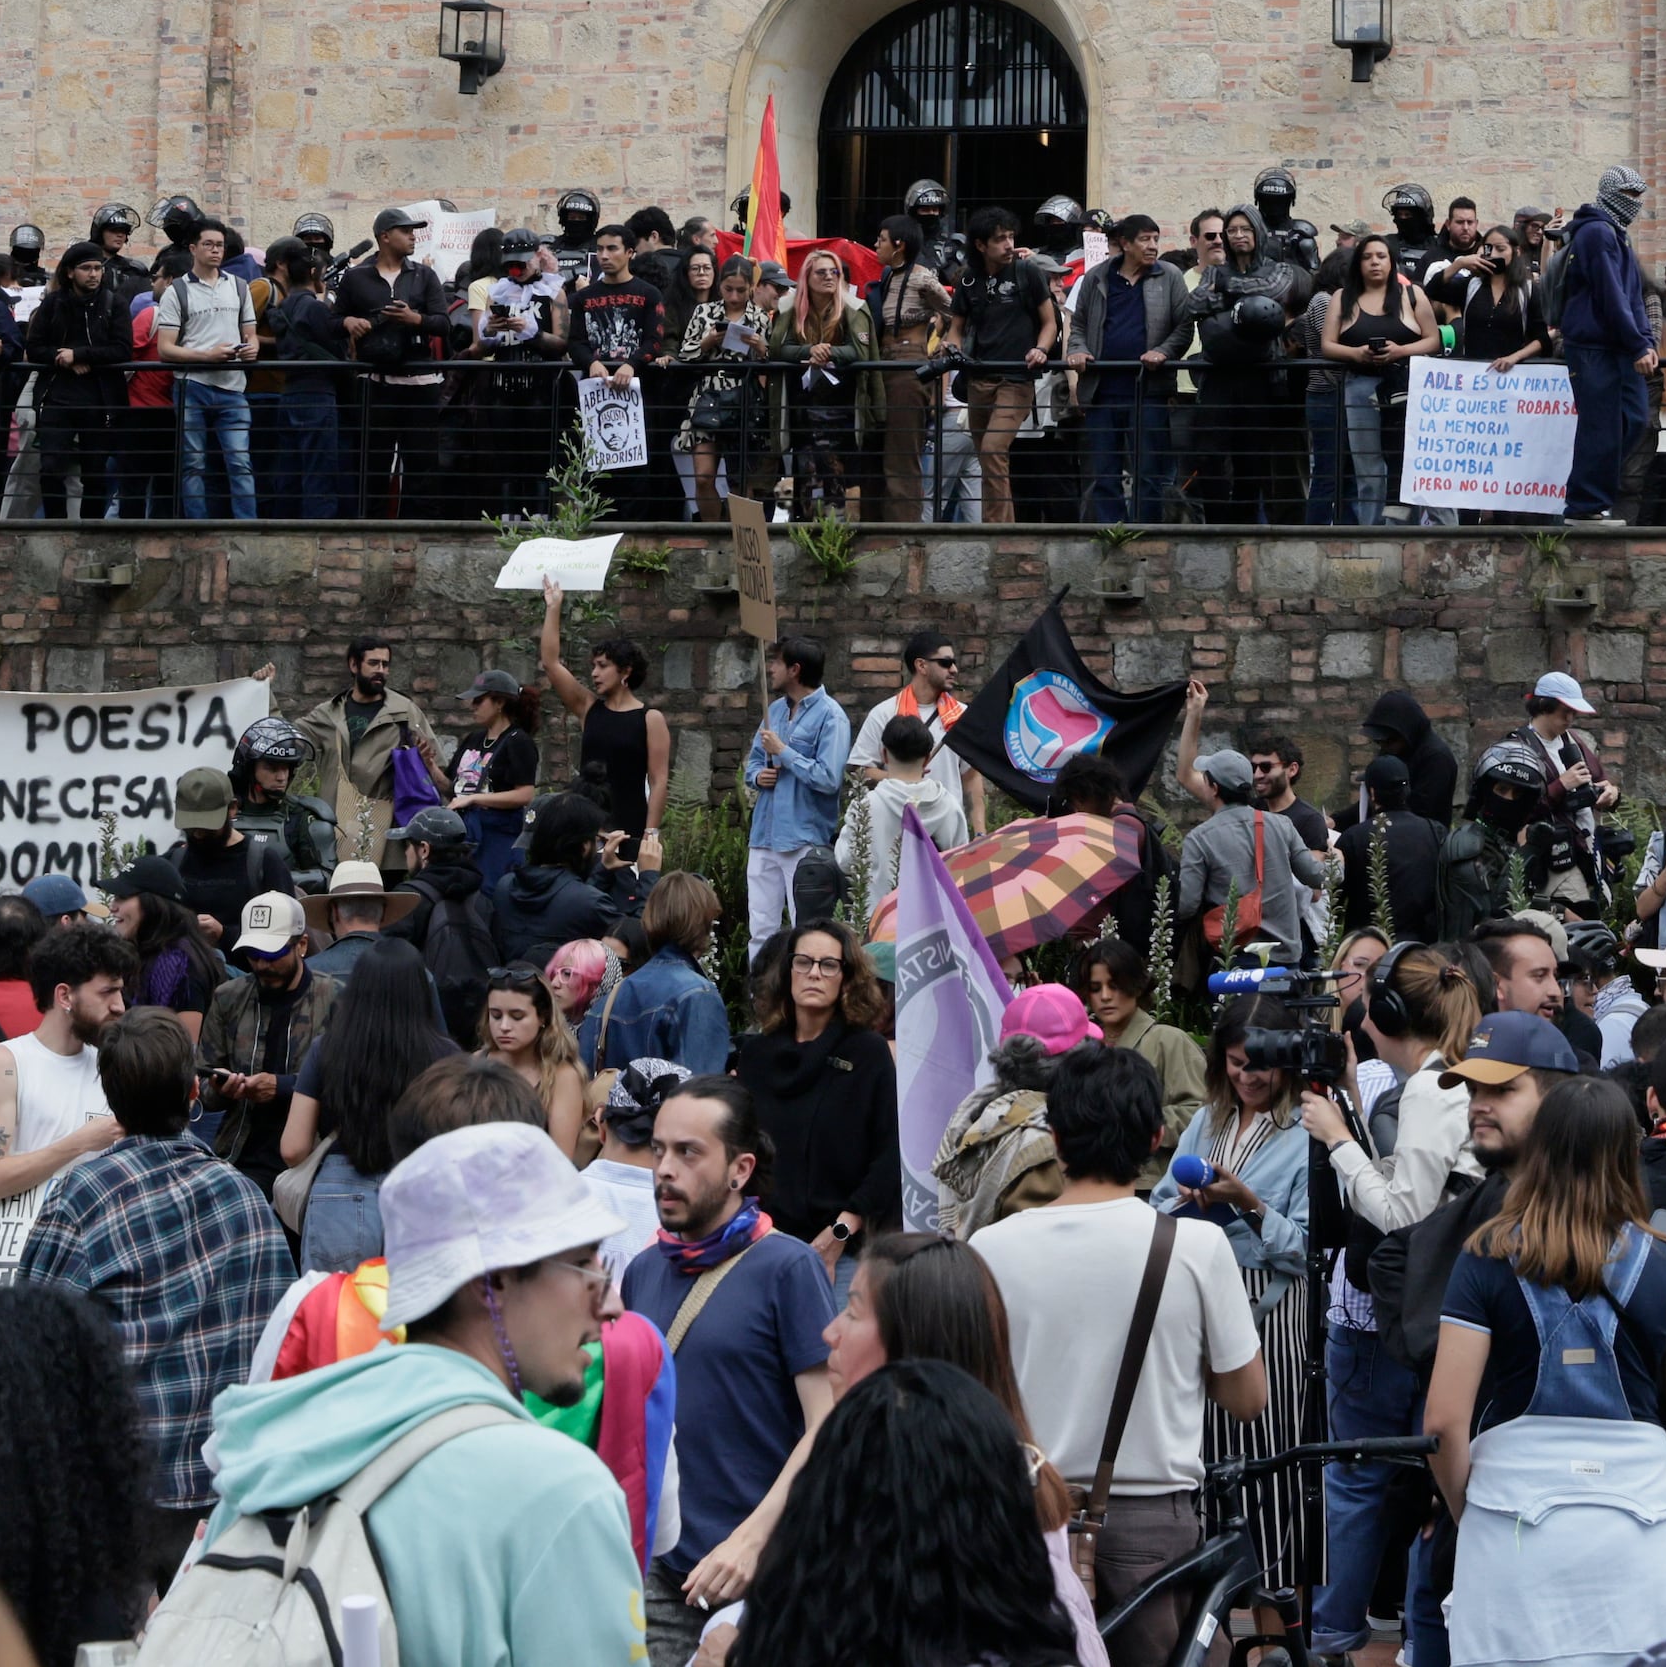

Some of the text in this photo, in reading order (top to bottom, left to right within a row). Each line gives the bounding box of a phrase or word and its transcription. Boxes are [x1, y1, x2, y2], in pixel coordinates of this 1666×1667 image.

[1423, 371, 1570, 392] ADLE ES UN PIRATA
[584, 388, 639, 413] ABELARDO
[1420, 394, 1450, 413] QUE
[1456, 398, 1507, 414] QUIERE
[1419, 418, 1510, 435] LA MEMORIA
[1417, 436, 1522, 457] HISTÓRICA DE
[1414, 457, 1493, 475] COLOMBIA
[1413, 476, 1451, 492] ¡PERO
[1459, 479, 1478, 491] NO
[1483, 481, 1498, 493] LO
[1052, 674, 1090, 709] MARICA
[21, 689, 237, 754] POESÍA
[1224, 971, 1250, 983] AFP
